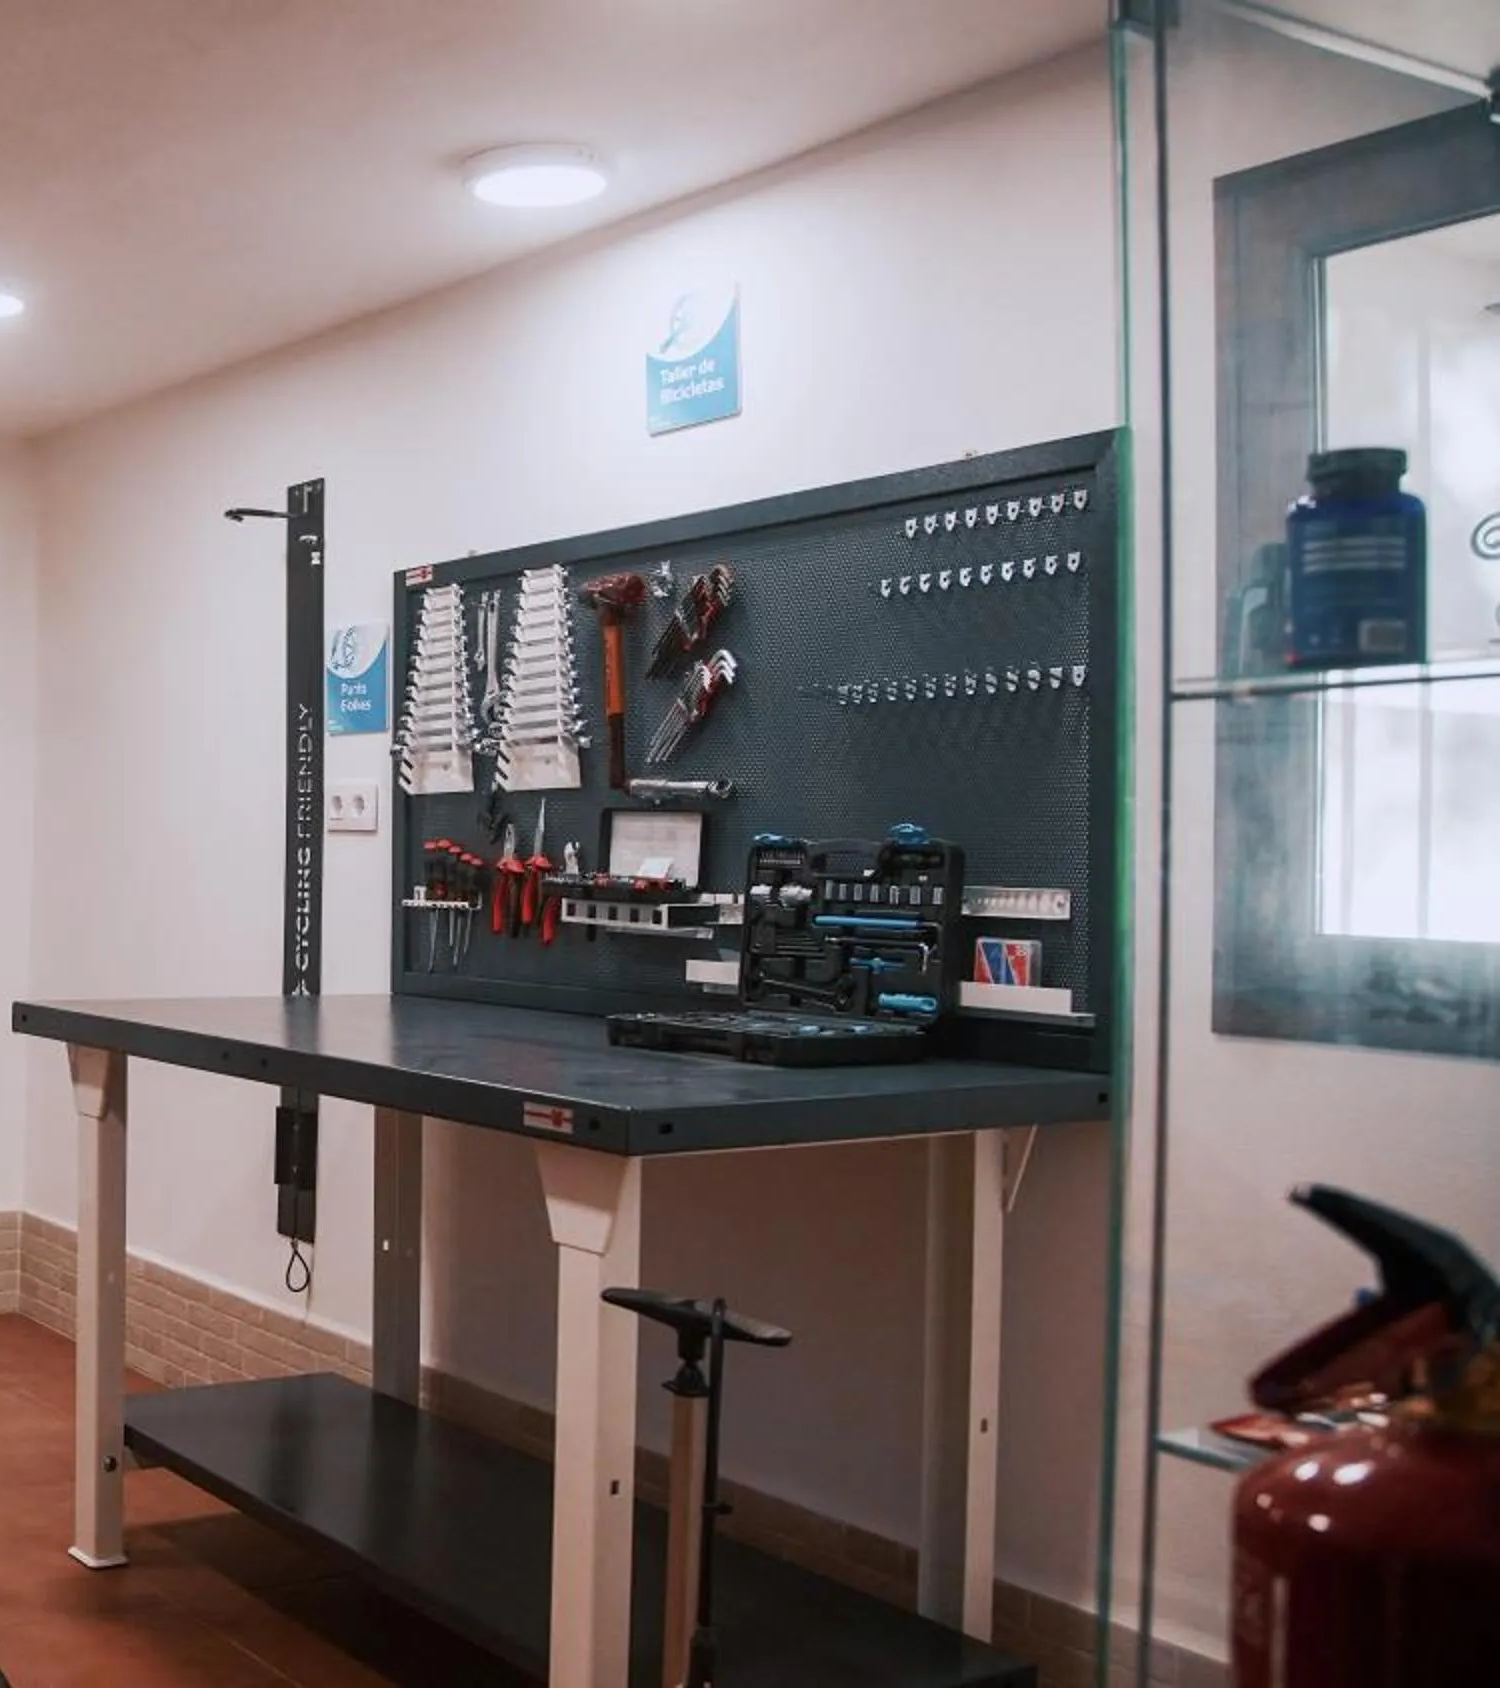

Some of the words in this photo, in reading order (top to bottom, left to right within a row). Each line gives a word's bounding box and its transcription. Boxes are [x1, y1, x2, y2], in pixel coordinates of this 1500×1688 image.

[698, 359, 716, 375] de
[297, 703, 313, 839] FRIENDLY
[296, 846, 311, 972] CYCLING
